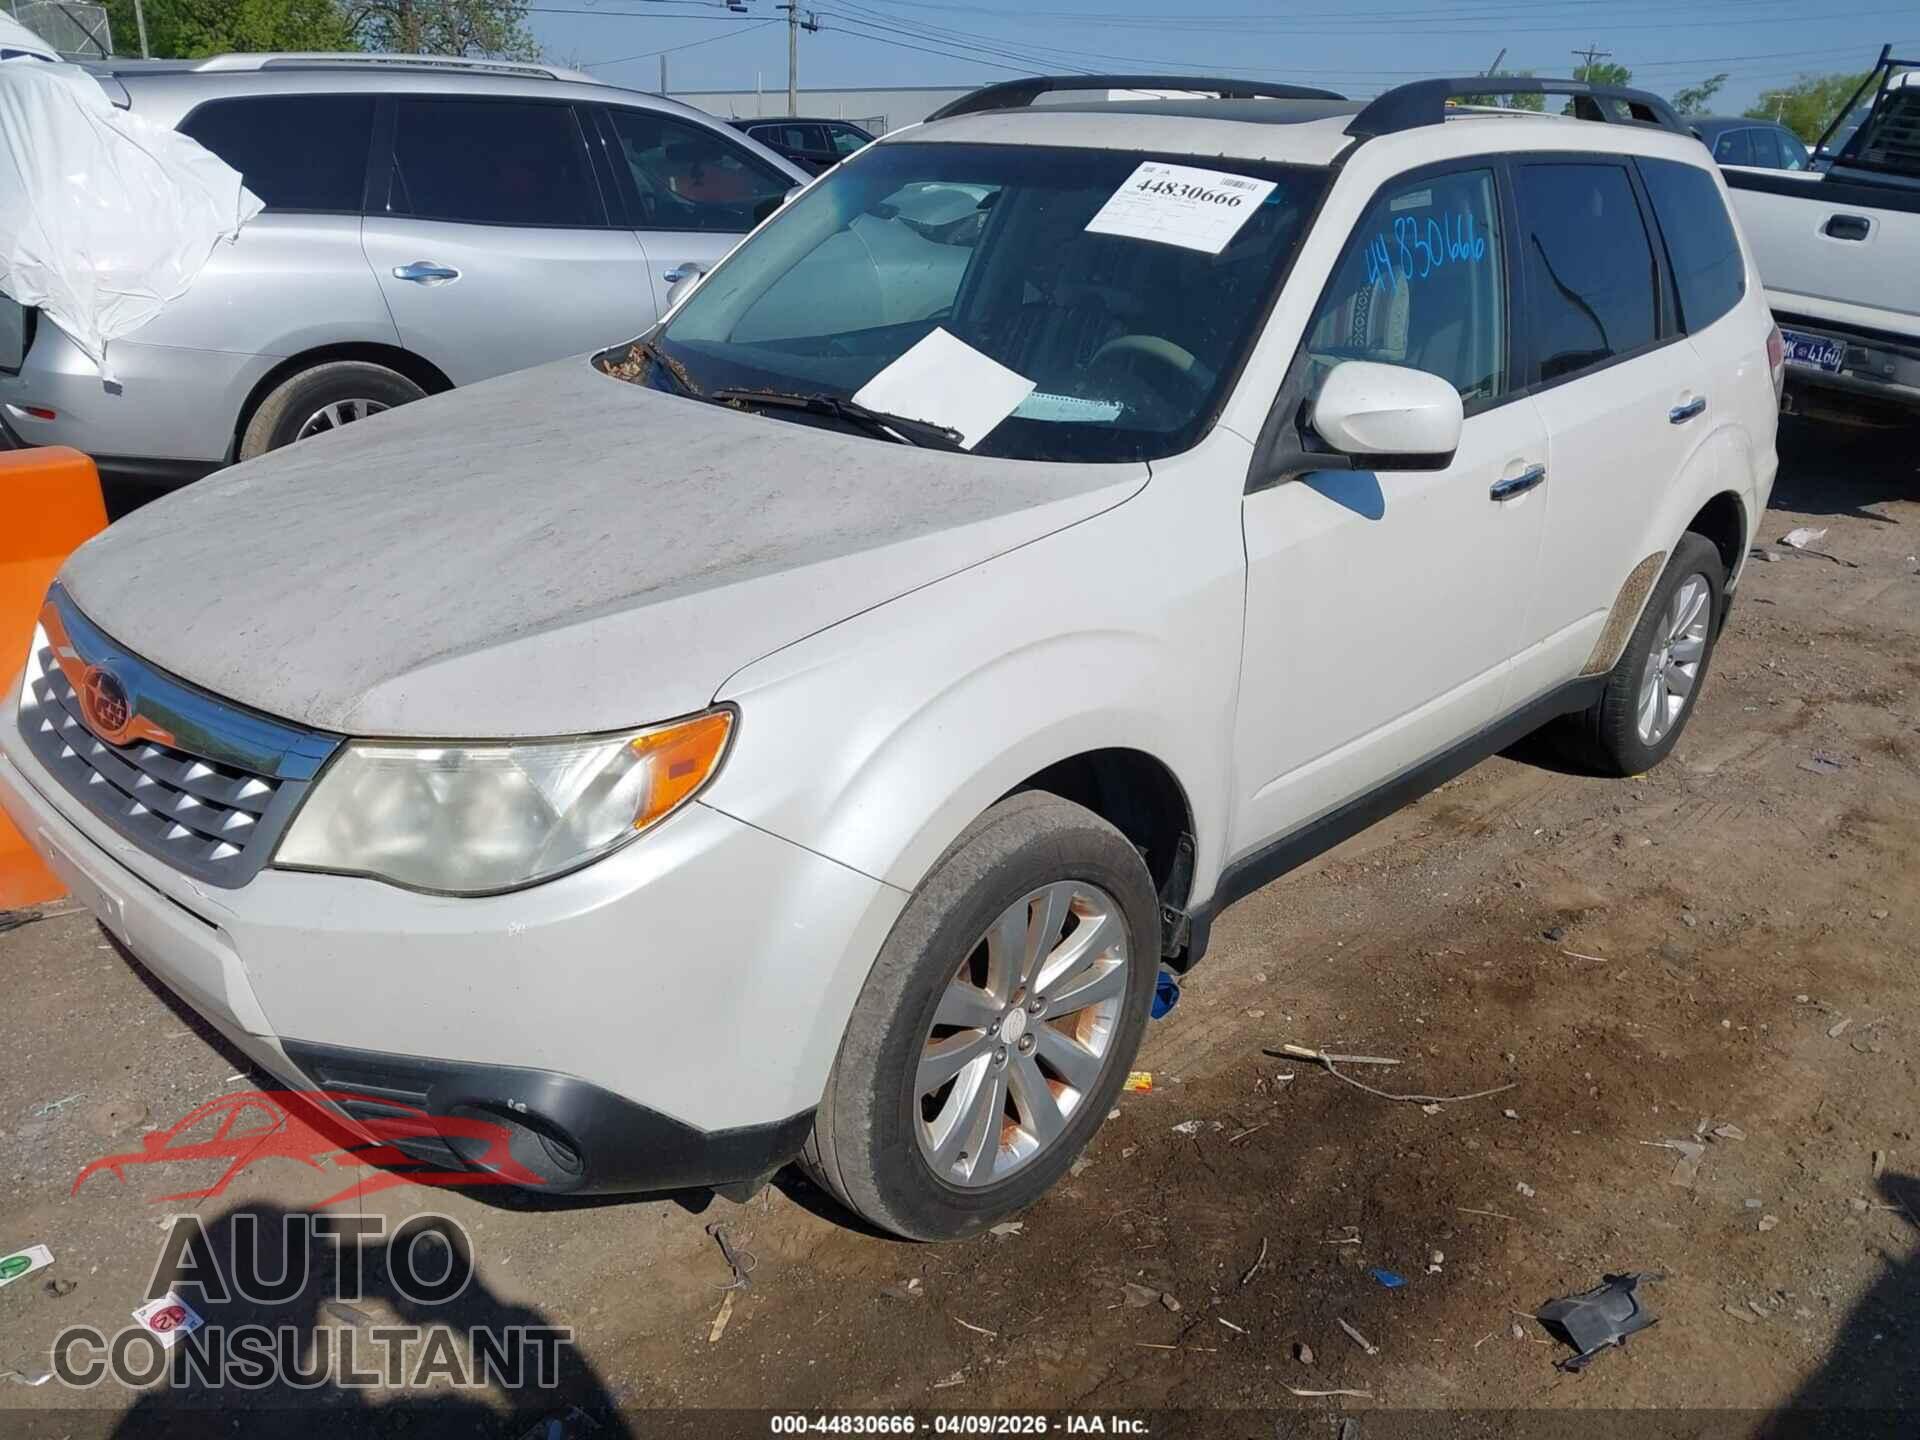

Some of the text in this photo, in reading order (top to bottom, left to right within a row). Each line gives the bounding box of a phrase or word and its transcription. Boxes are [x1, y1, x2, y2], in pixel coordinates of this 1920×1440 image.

[1136, 178, 1246, 208] 44830666
[1365, 210, 1484, 292] 44830666
[1808, 343, 1841, 366] 4160
